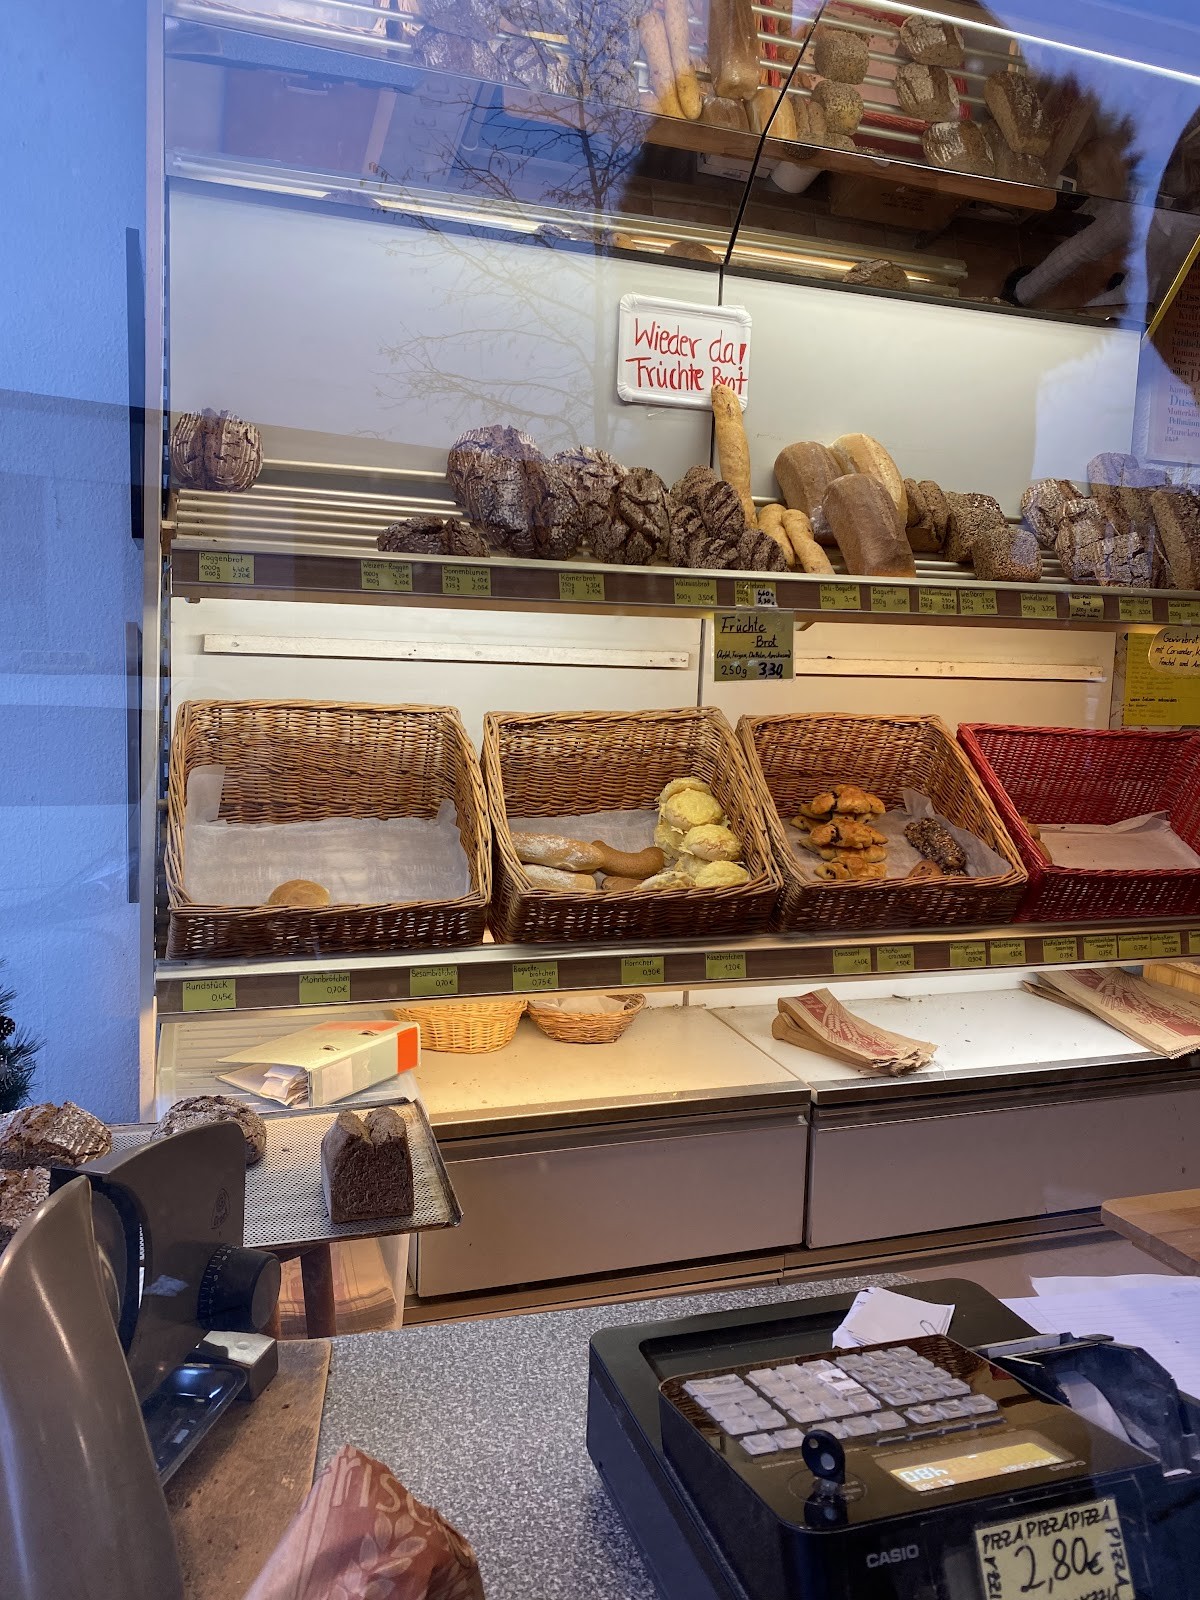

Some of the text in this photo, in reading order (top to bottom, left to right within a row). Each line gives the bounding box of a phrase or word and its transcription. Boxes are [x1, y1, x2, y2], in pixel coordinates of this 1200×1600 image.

[634, 318, 747, 371] Wieder da!
[625, 357, 704, 391] Früchte
[200, 552, 244, 564] Roggenbrot
[201, 564, 220, 573] 1000g
[720, 616, 767, 633] Früchte
[721, 664, 748, 679] 250g
[211, 993, 234, 1002] 0,45€
[866, 1544, 919, 1569] CASIO
[1014, 1537, 1104, 1594] 2,80€
